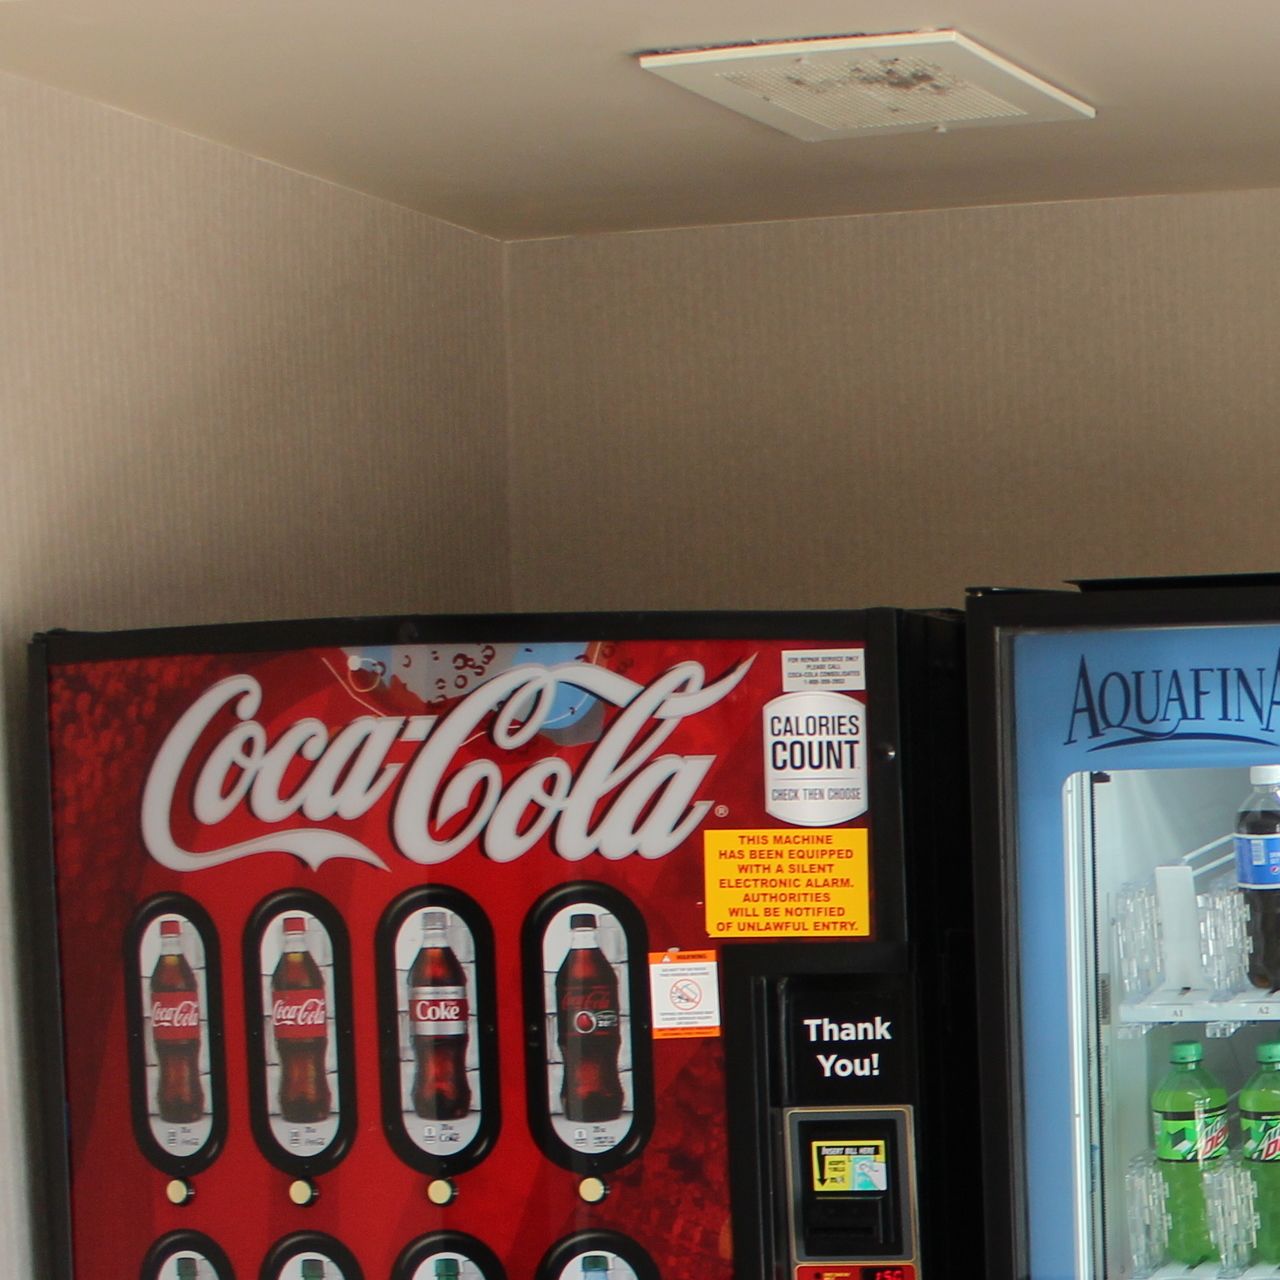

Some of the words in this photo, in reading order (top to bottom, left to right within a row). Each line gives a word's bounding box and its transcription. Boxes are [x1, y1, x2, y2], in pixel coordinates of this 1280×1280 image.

[771, 715, 860, 737] CALORIES
[772, 740, 860, 770] COUNT
[772, 788, 799, 801] CHECK
[802, 788, 824, 800] THEN
[827, 787, 861, 800] CHOOSE
[738, 835, 768, 845] THIS
[773, 835, 833, 844] MACHINE
[719, 850, 745, 859] HAS
[749, 849, 784, 859] BEEN
[788, 849, 854, 859] EQUIPPED
[737, 864, 771, 873] WITH
[776, 864, 784, 873] A
[788, 864, 834, 873] SILENT
[719, 878, 801, 888] ELECTRONIC
[805, 878, 854, 888] ALARM.
[742, 892, 831, 902] AUTHORITIES
[728, 907, 759, 917] WILL
[763, 907, 781, 916] BE
[785, 907, 845, 916] NOTIFIED
[716, 922, 733, 932] OF
[737, 921, 808, 931] UNLAWFUL
[813, 921, 859, 931] ENTRY.
[416, 1001, 460, 1021] Coke
[803, 1016, 892, 1042] Thank
[817, 1053, 880, 1077] You!
